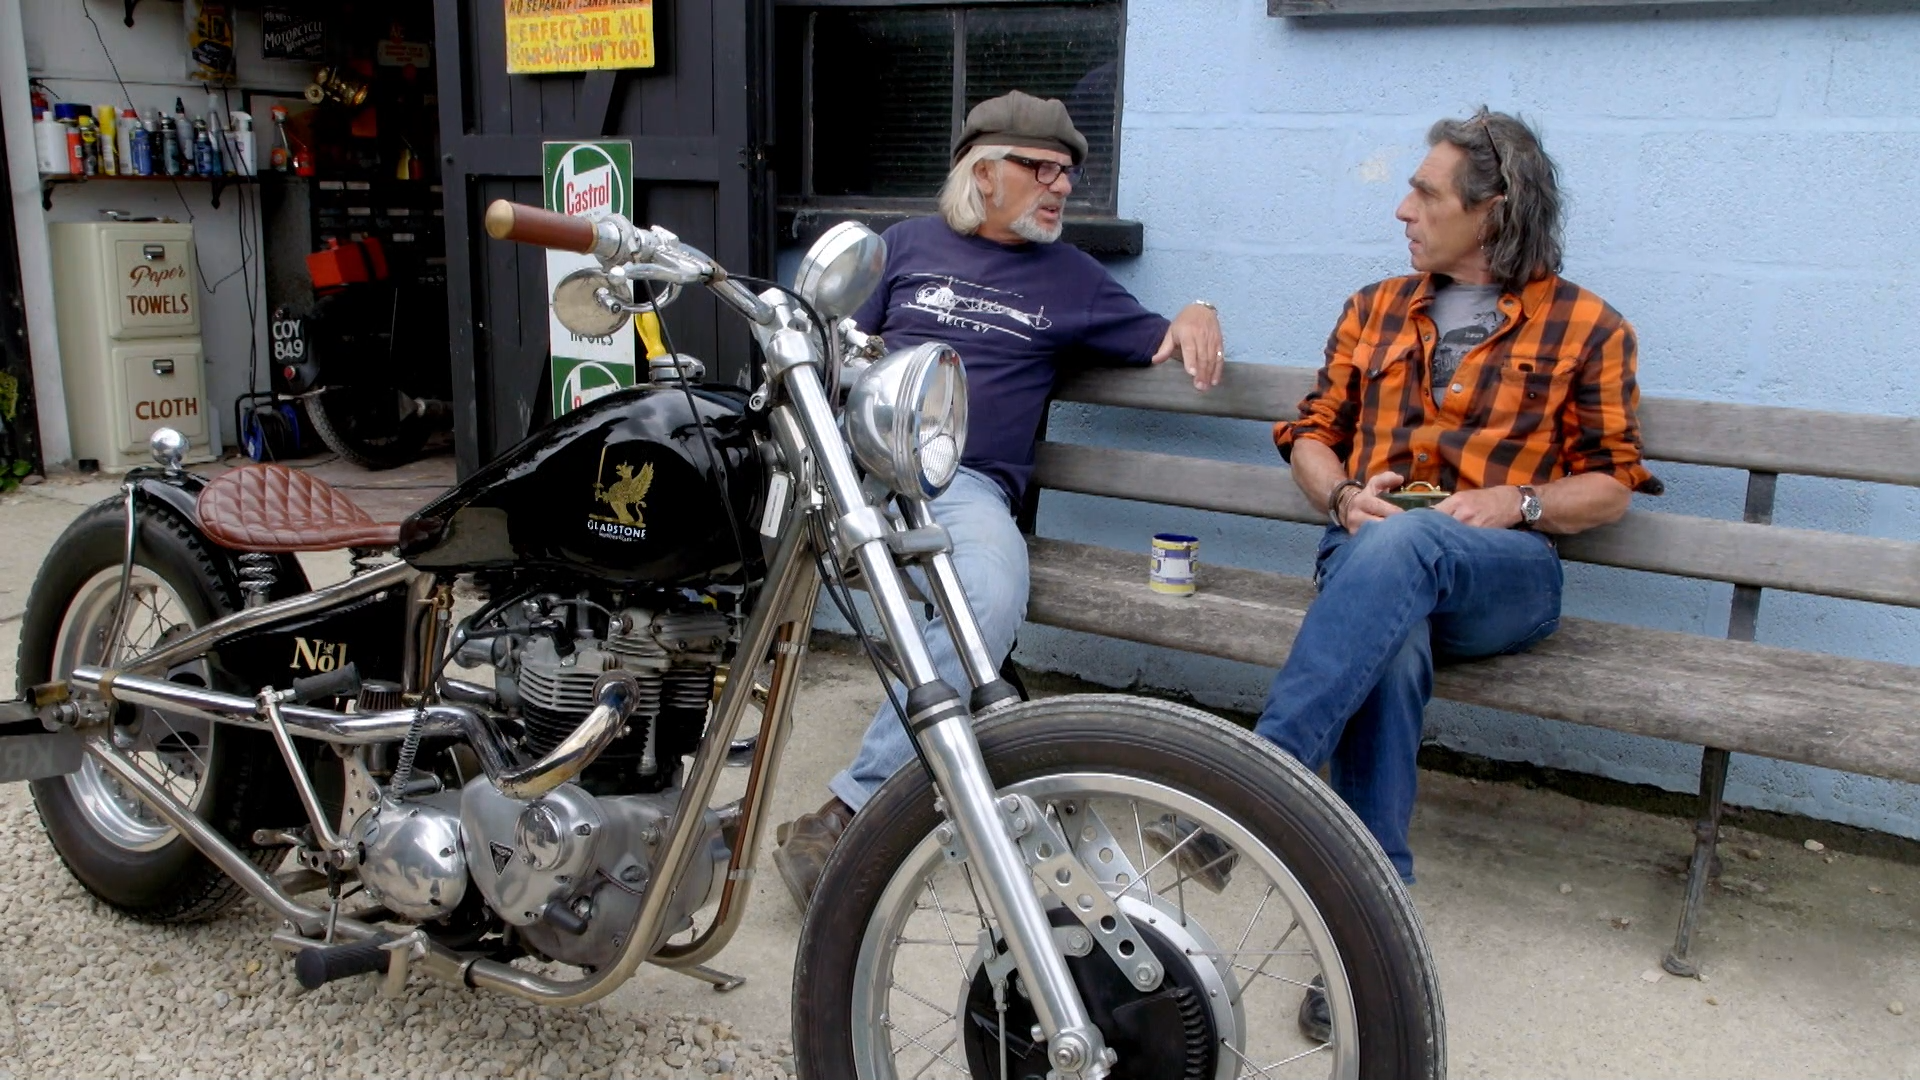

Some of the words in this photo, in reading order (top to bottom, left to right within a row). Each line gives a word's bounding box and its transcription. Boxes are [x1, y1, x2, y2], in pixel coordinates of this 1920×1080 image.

[618, 13, 647, 35] ALL
[566, 171, 610, 216] Castrol
[130, 264, 186, 288] Paper
[126, 293, 189, 316] TOWELS
[272, 319, 301, 340] COY
[274, 339, 304, 360] 849
[135, 397, 198, 420] CLOTH
[587, 519, 647, 538] GLADSTONE
